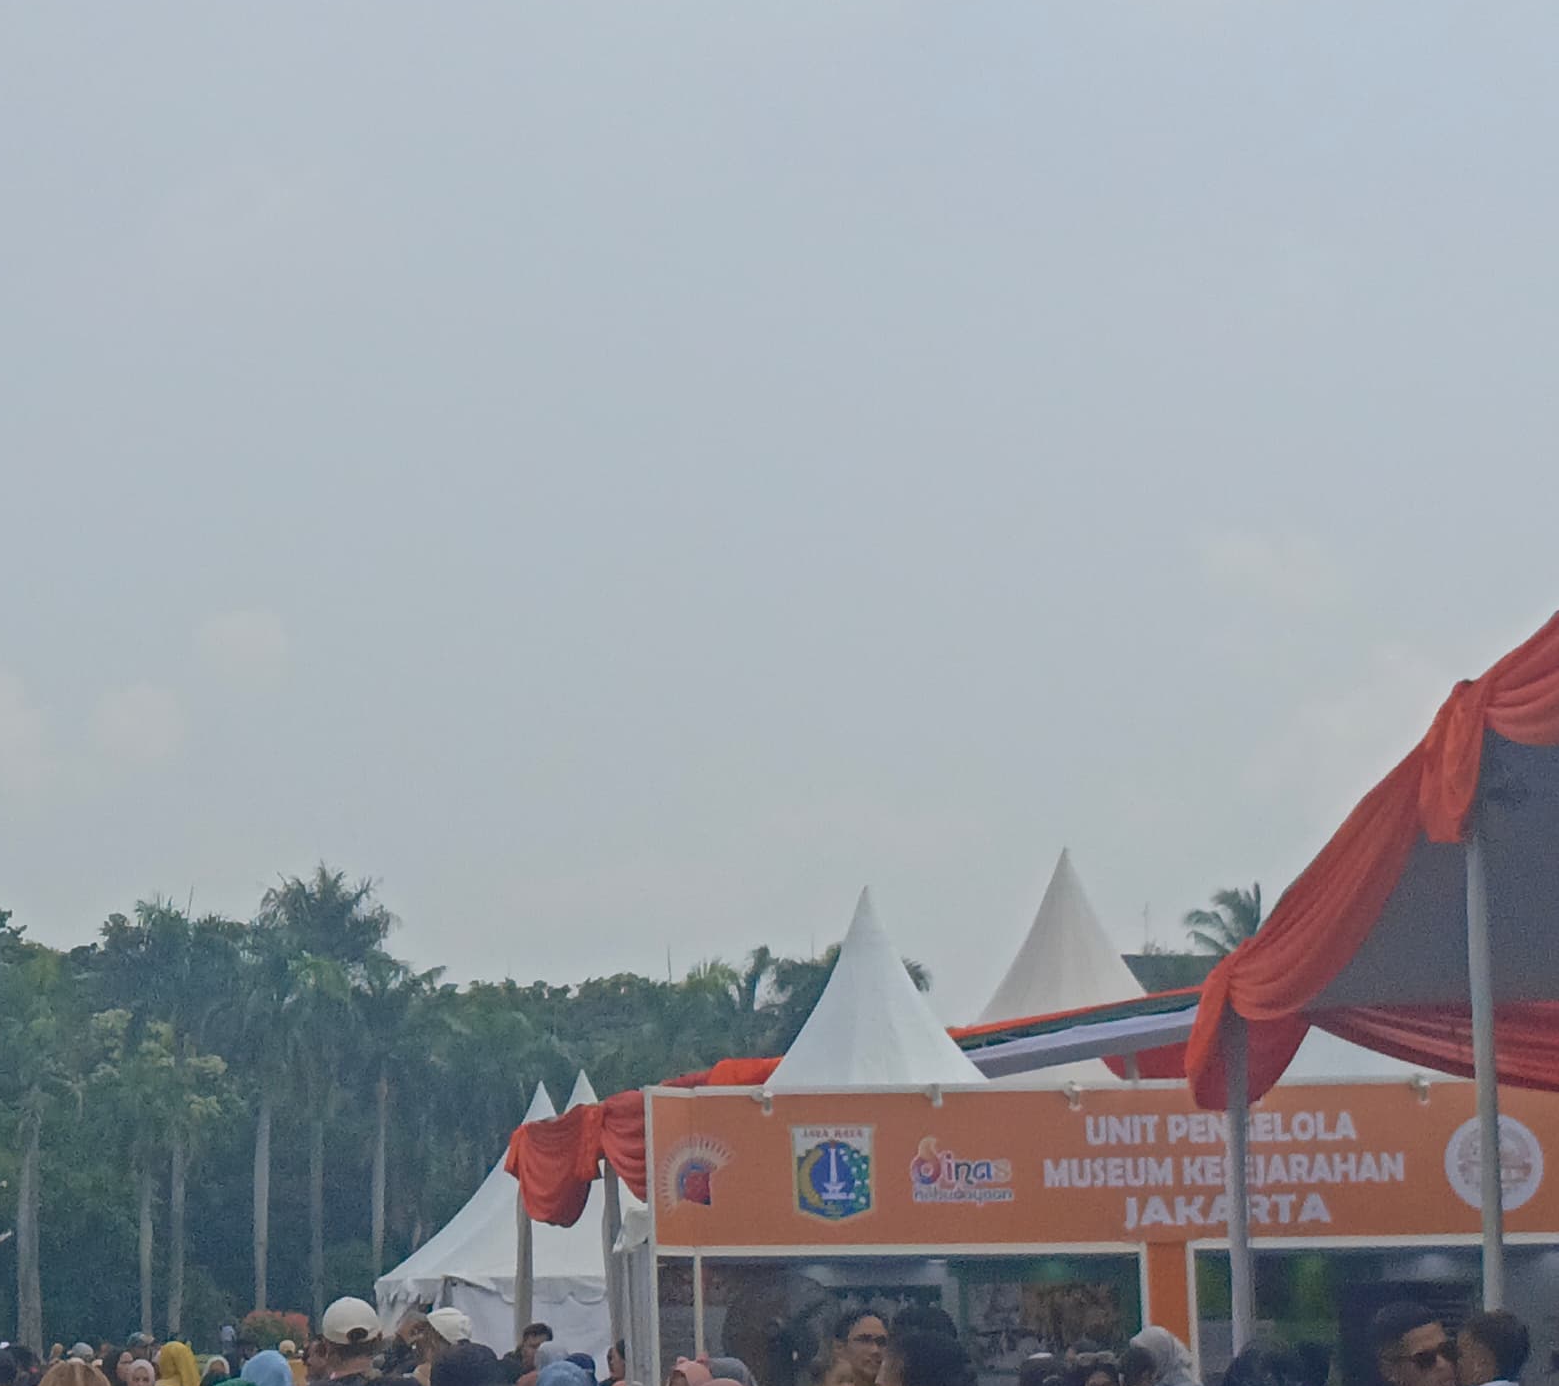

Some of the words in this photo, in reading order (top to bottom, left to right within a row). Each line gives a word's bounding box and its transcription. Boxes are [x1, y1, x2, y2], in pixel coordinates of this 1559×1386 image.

[1085, 1114, 1159, 1145] UNIT
[1167, 1111, 1357, 1144] PENELOLA
[1043, 1156, 1174, 1188] MUSEUM
[1182, 1150, 1405, 1187] KEEJARAHAN
